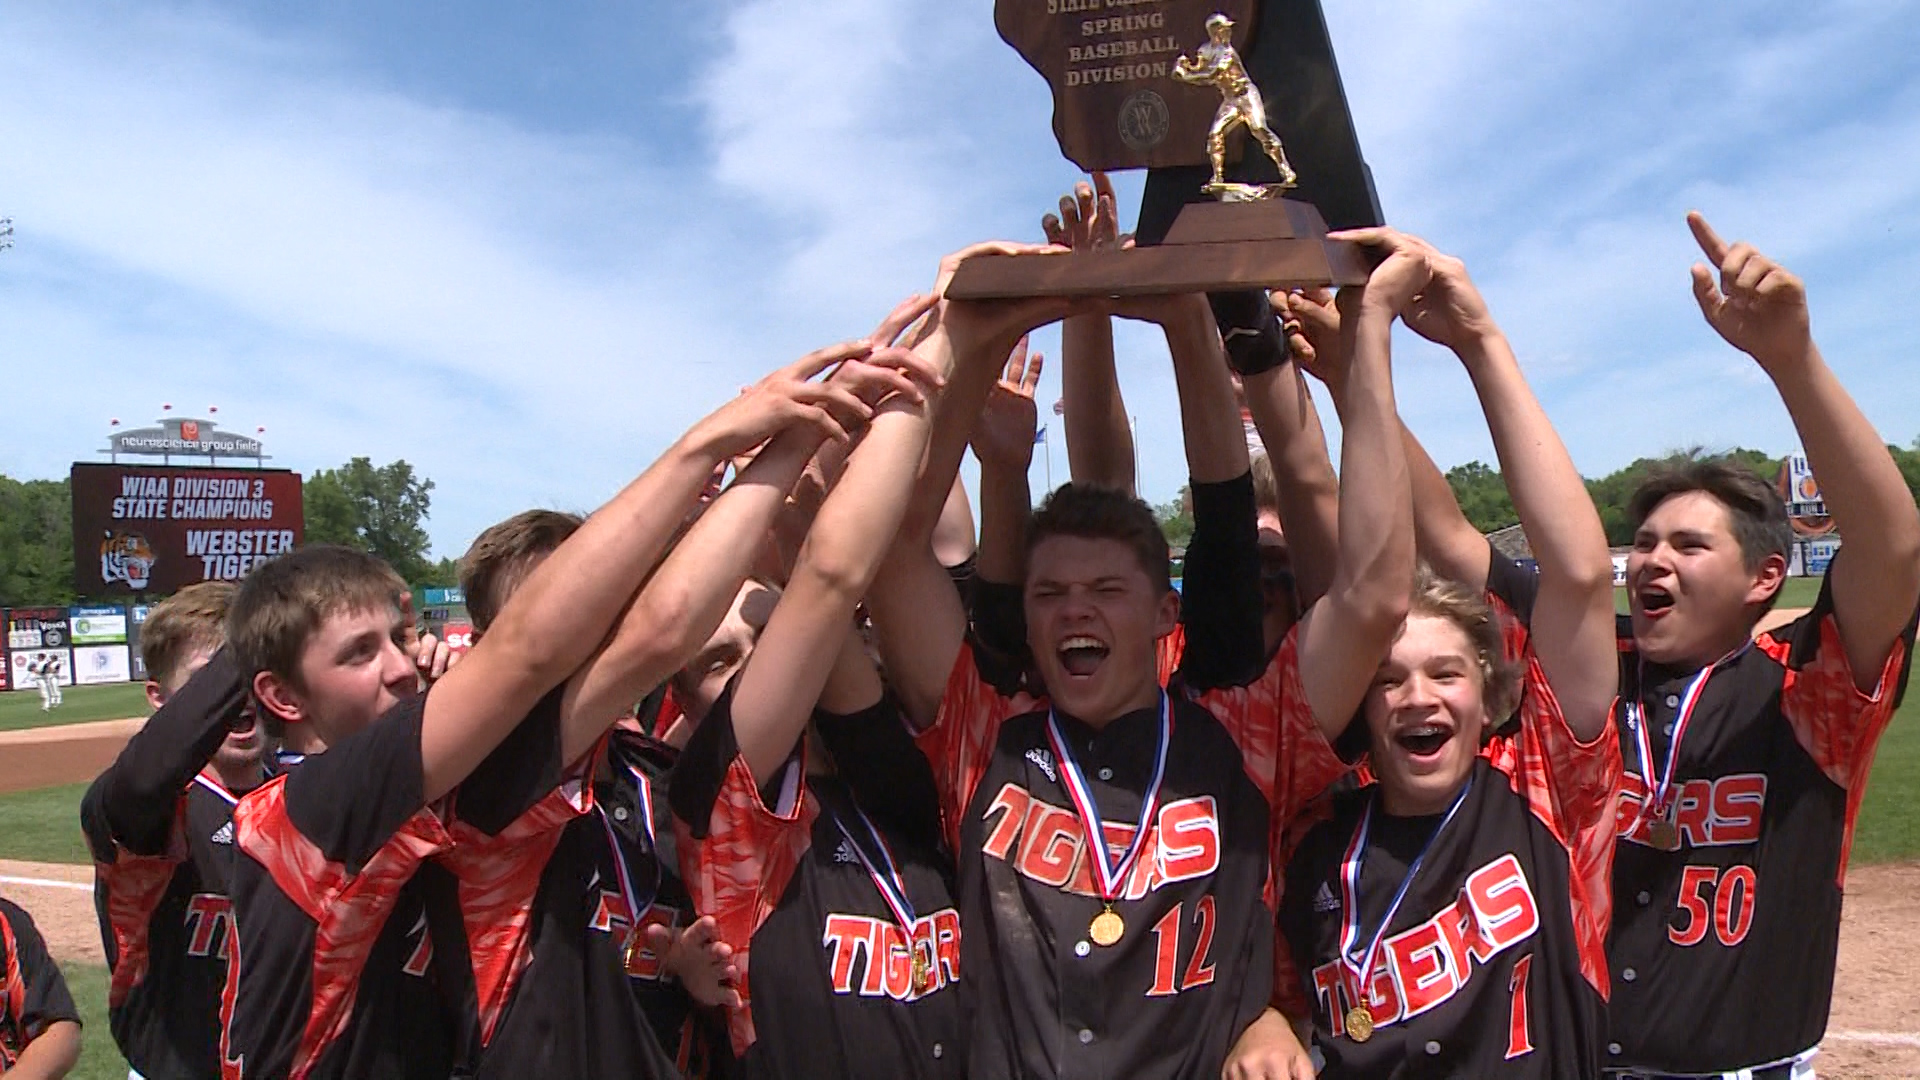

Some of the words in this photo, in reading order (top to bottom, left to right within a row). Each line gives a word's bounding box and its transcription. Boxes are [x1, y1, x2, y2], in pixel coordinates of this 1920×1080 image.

[1081, 13, 1164, 36] SPRING
[1068, 36, 1179, 62] BASEBALL
[1065, 61, 1167, 86] DIVISION
[202, 440, 234, 452] group
[236, 439, 258, 450] field
[122, 475, 169, 498] WIAA
[173, 477, 249, 499] DIVISION
[253, 479, 264, 498] 3
[112, 497, 167, 519] STATE
[171, 499, 274, 520] CHAMPIONS
[186, 529, 294, 556] WEBSTER
[1668, 865, 1756, 946] 50
[1145, 894, 1217, 998] 12
[1504, 953, 1536, 1060] 1
